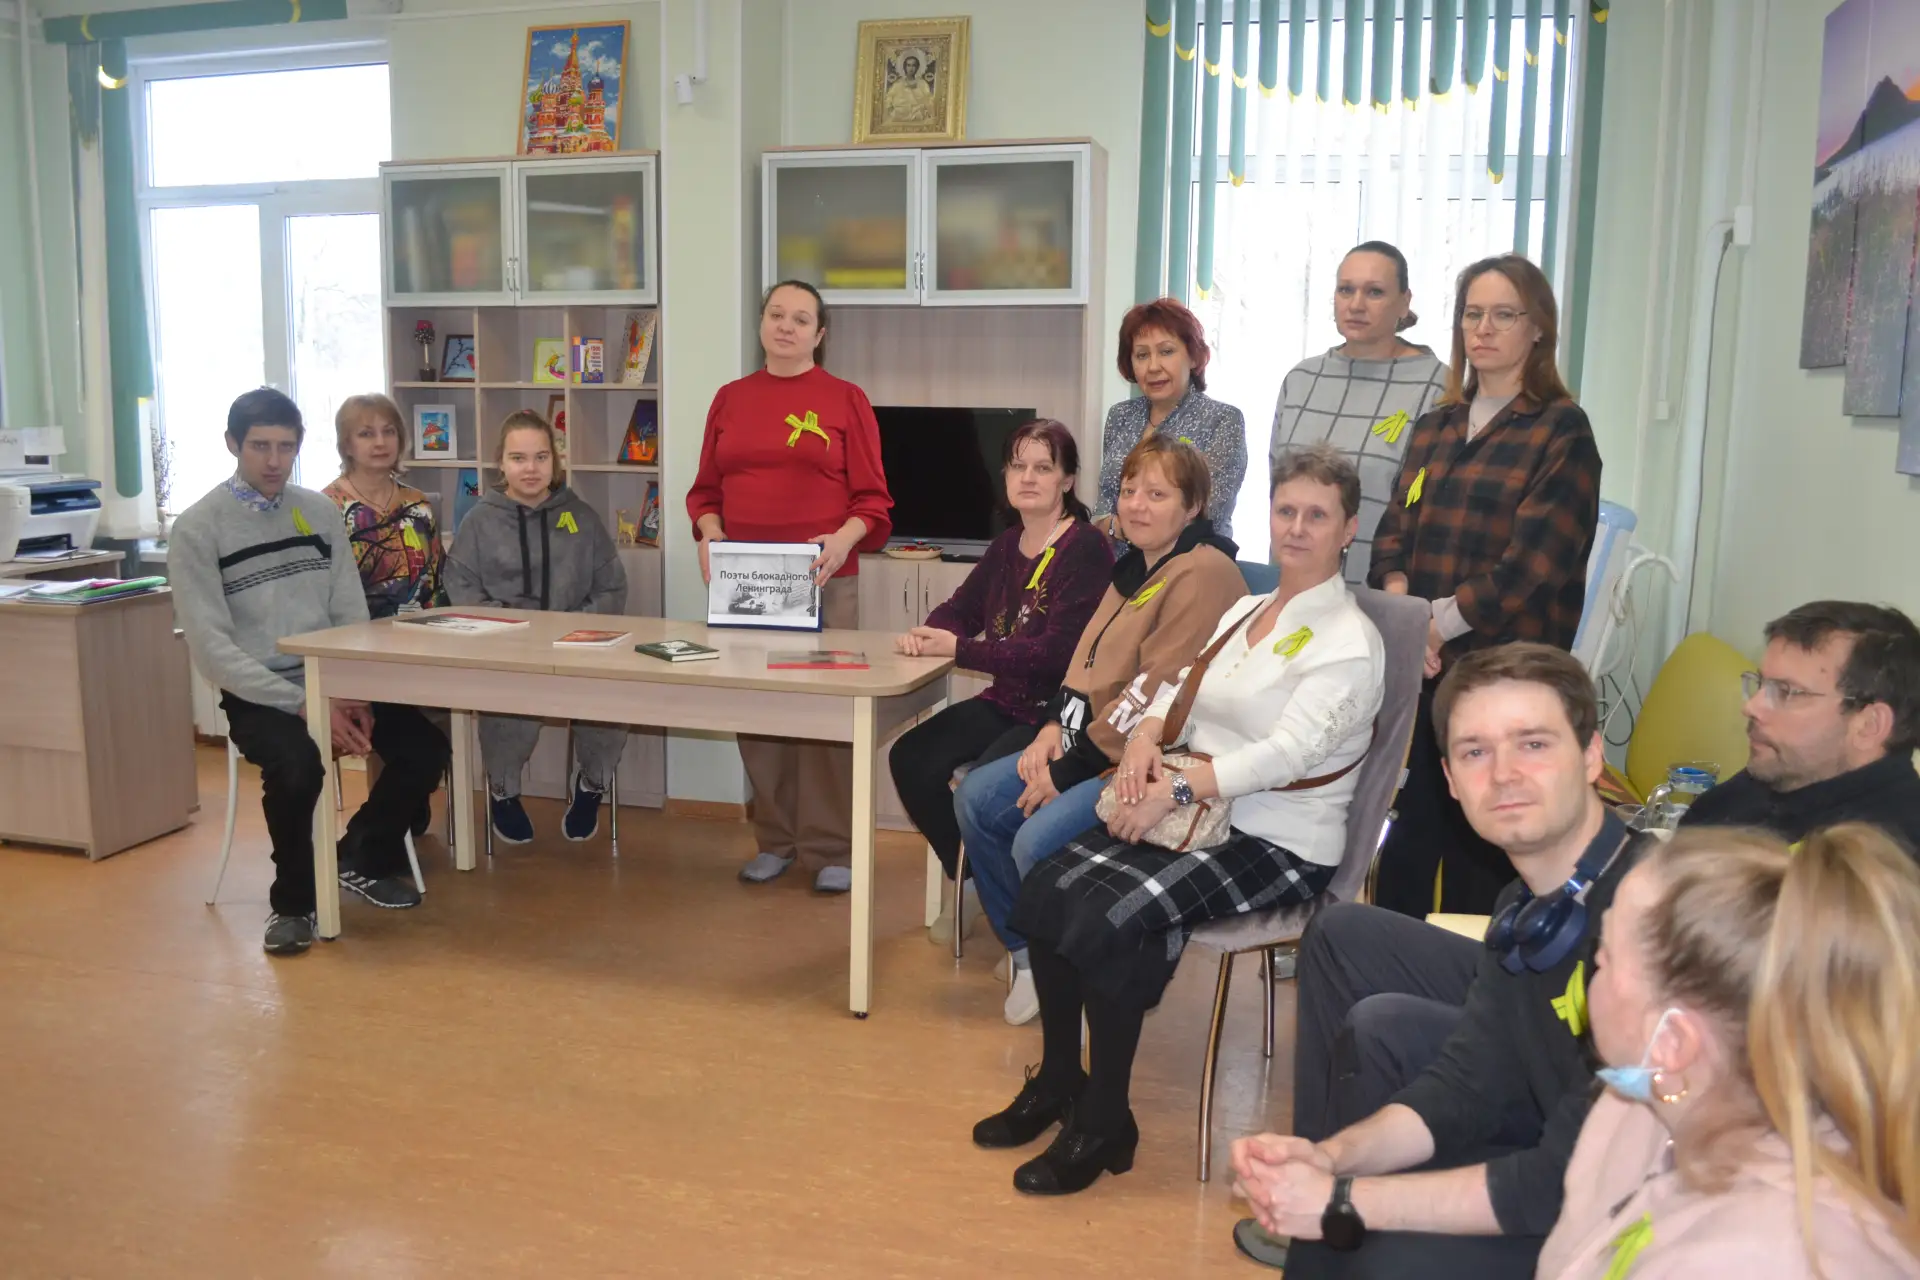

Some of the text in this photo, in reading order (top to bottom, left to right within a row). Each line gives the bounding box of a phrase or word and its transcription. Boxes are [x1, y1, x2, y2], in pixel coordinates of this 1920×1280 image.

[720, 570, 809, 581] Поэты блокадного
[735, 583, 792, 595] Ленинграда
